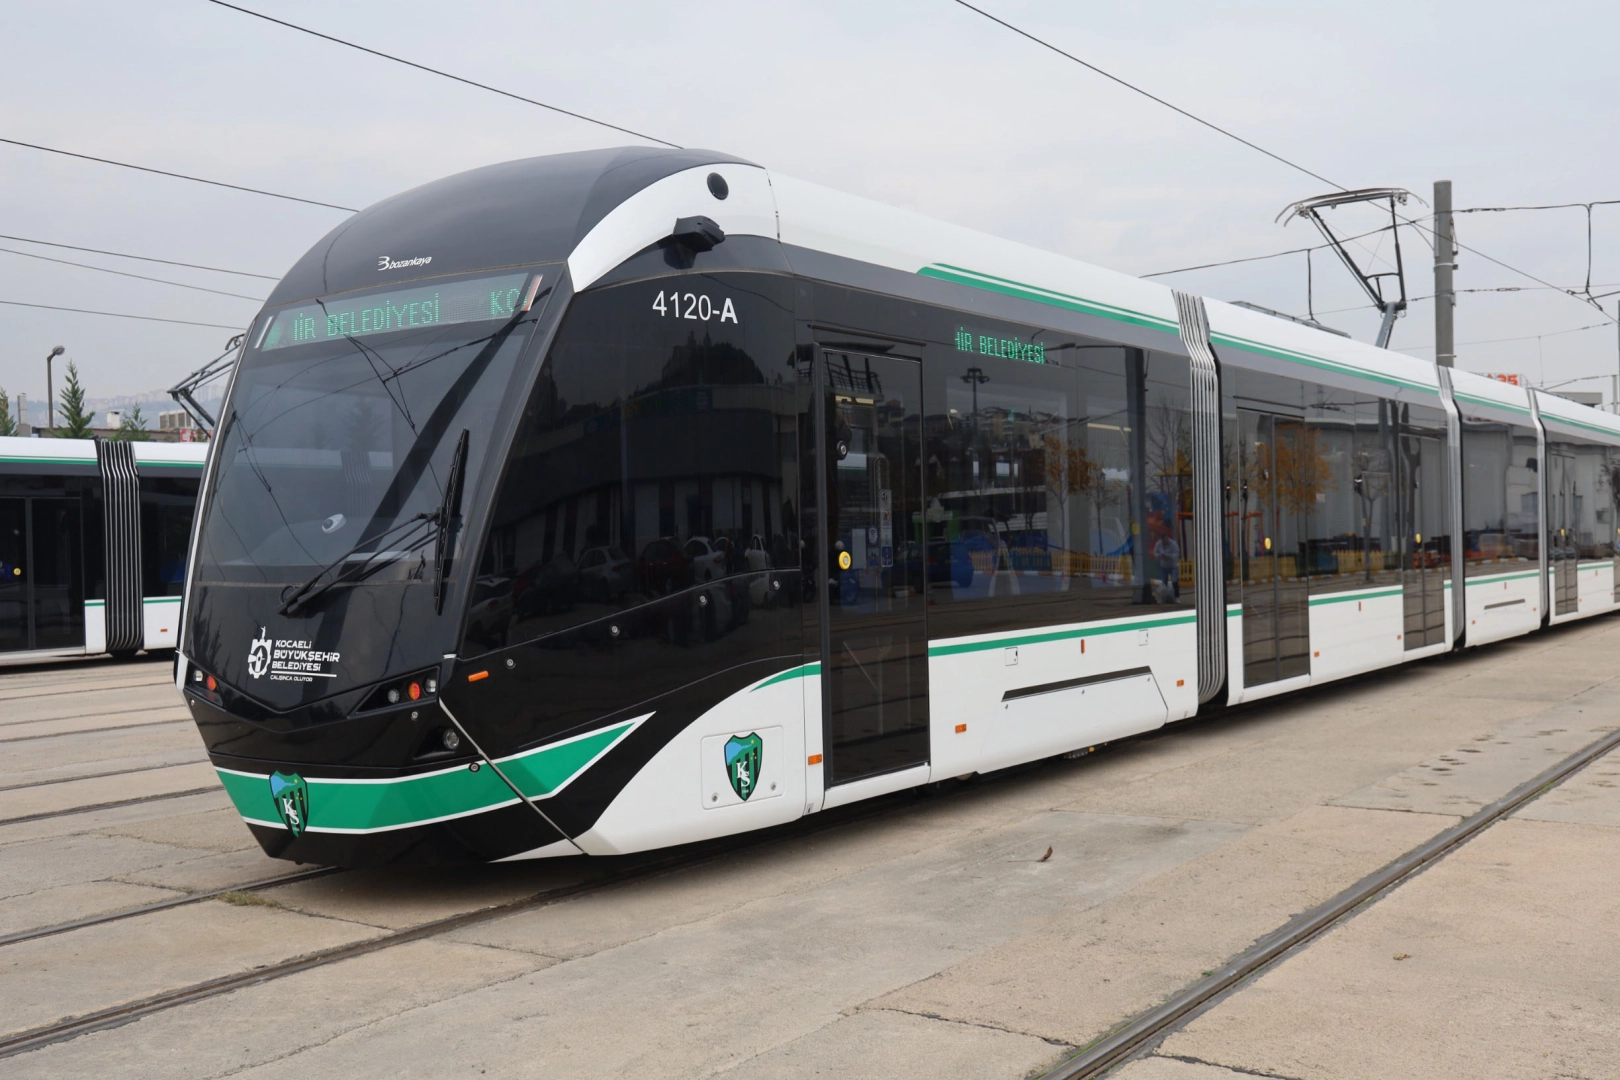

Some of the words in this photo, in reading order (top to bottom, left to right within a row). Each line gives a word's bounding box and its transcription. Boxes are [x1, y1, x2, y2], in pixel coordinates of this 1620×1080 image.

[389, 256, 432, 269] bozankaya
[327, 293, 439, 336] BELEDİYESİ
[652, 290, 738, 324] 4120-A
[979, 335, 1045, 364] BELEDİYESİ
[271, 661, 321, 671] BELEDİYESİ
[273, 649, 340, 663] BÜYÜKŞEHİR
